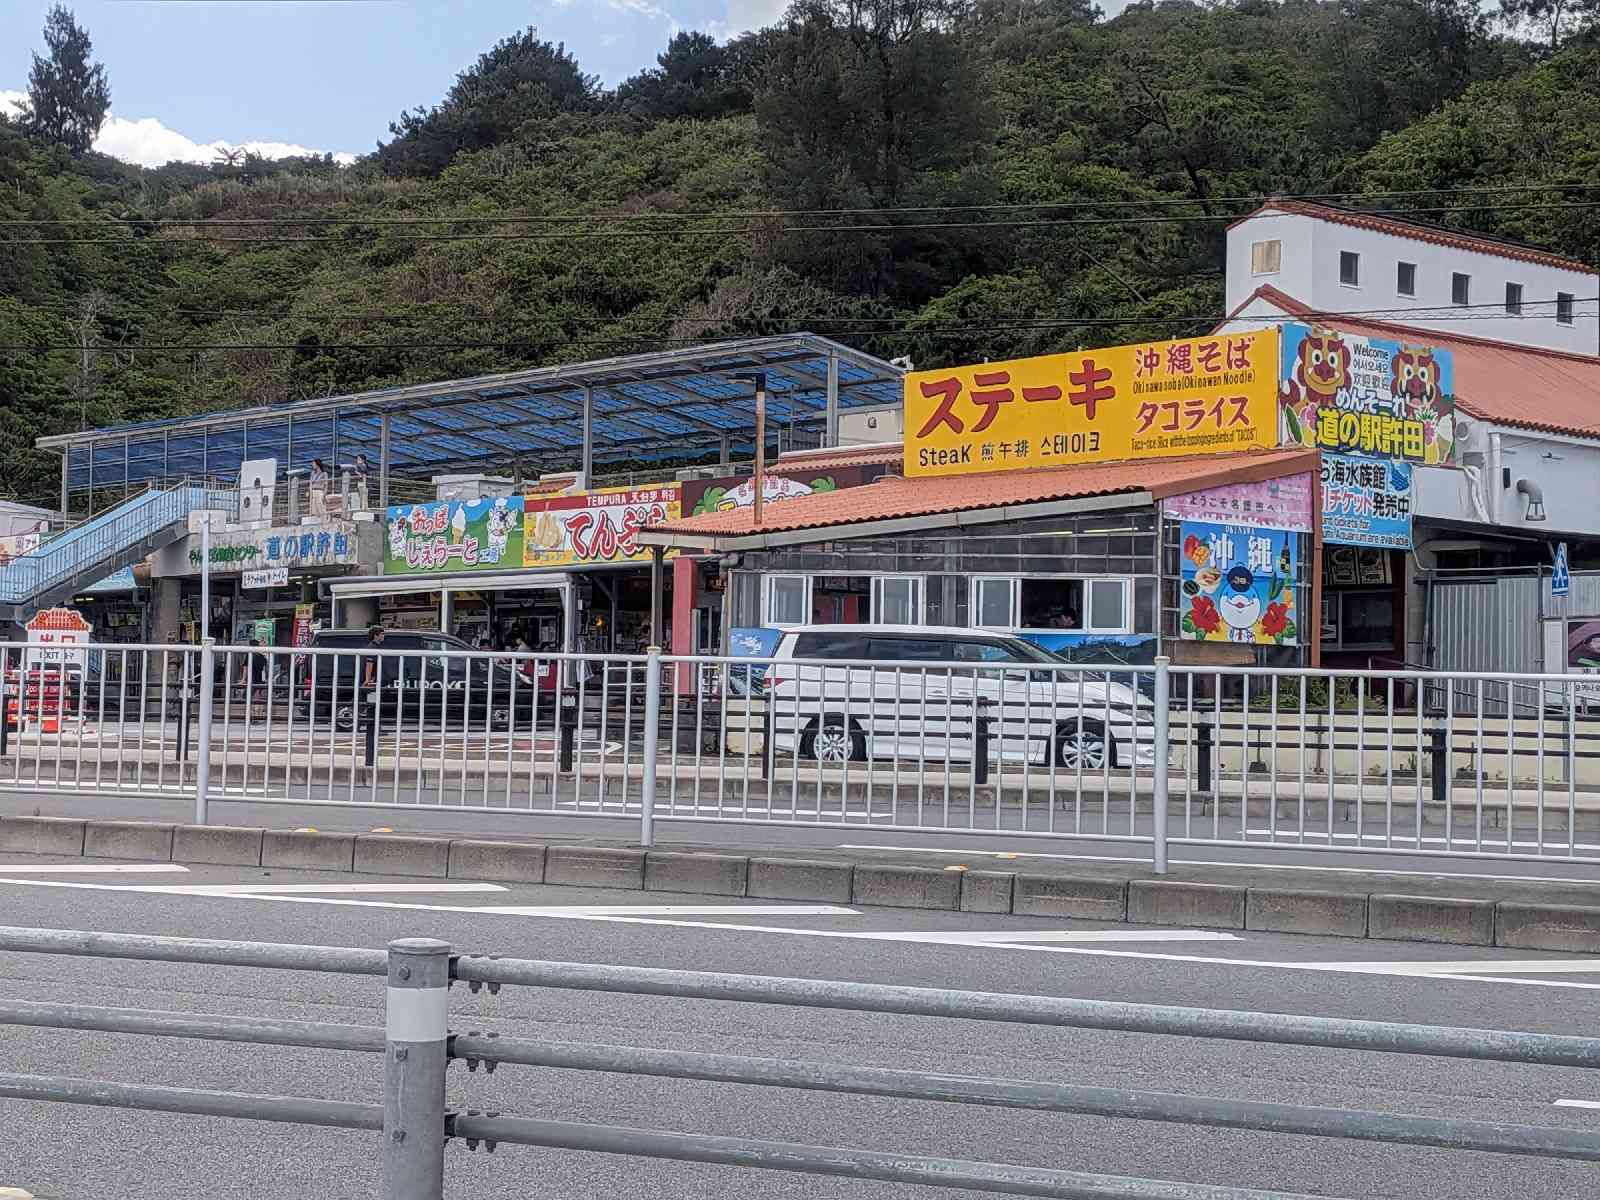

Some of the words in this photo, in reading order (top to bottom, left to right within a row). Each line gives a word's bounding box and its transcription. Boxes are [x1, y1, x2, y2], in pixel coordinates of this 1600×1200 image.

[1135, 336, 1257, 378] 沖縄そば
[1353, 343, 1389, 360] Welcome
[915, 359, 1117, 440] ステーキ
[1135, 396, 1250, 434] タコライス
[1335, 387, 1407, 419] めんそーれ
[1040, 431, 1101, 456] 스테이크
[1316, 408, 1425, 457] 道の駅許田
[586, 493, 627, 508] TEMPURA
